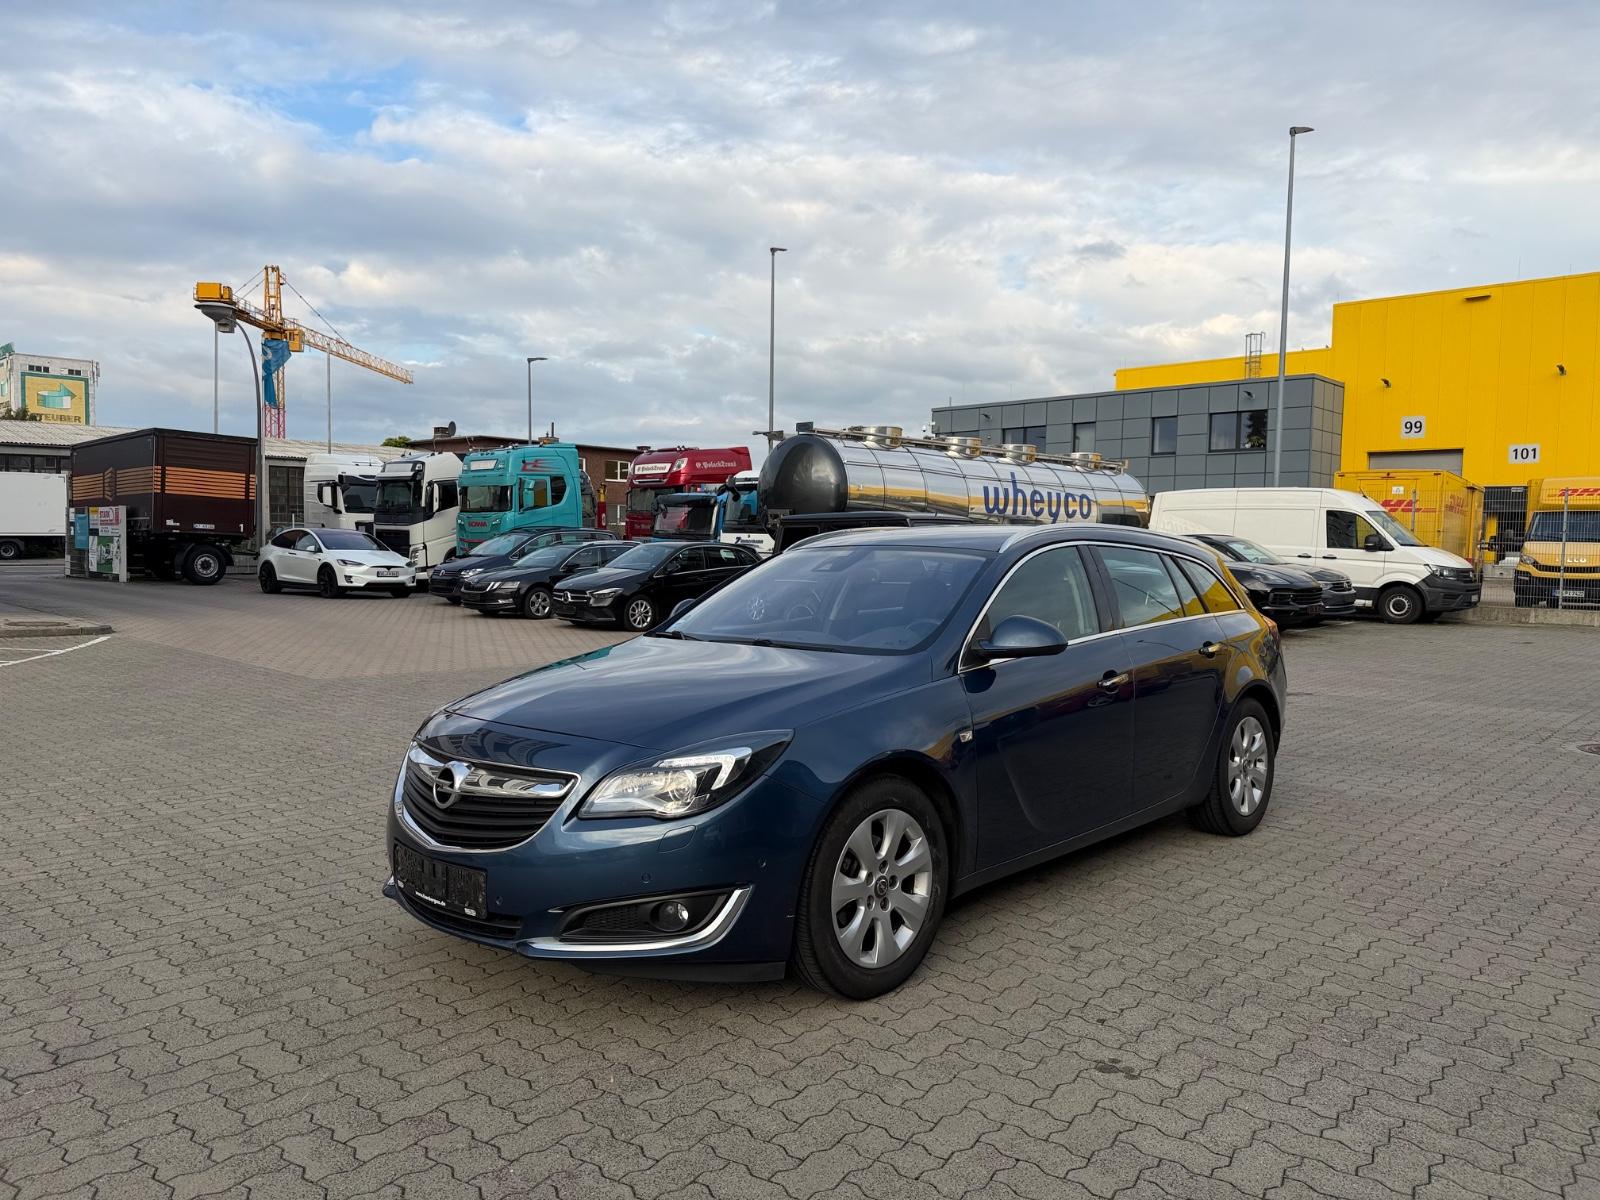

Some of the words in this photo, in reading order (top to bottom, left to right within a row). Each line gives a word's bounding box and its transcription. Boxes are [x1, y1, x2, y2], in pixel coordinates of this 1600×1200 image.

[1404, 420, 1423, 434] 99
[1512, 447, 1537, 460] 101
[983, 471, 1092, 524] wheyco
